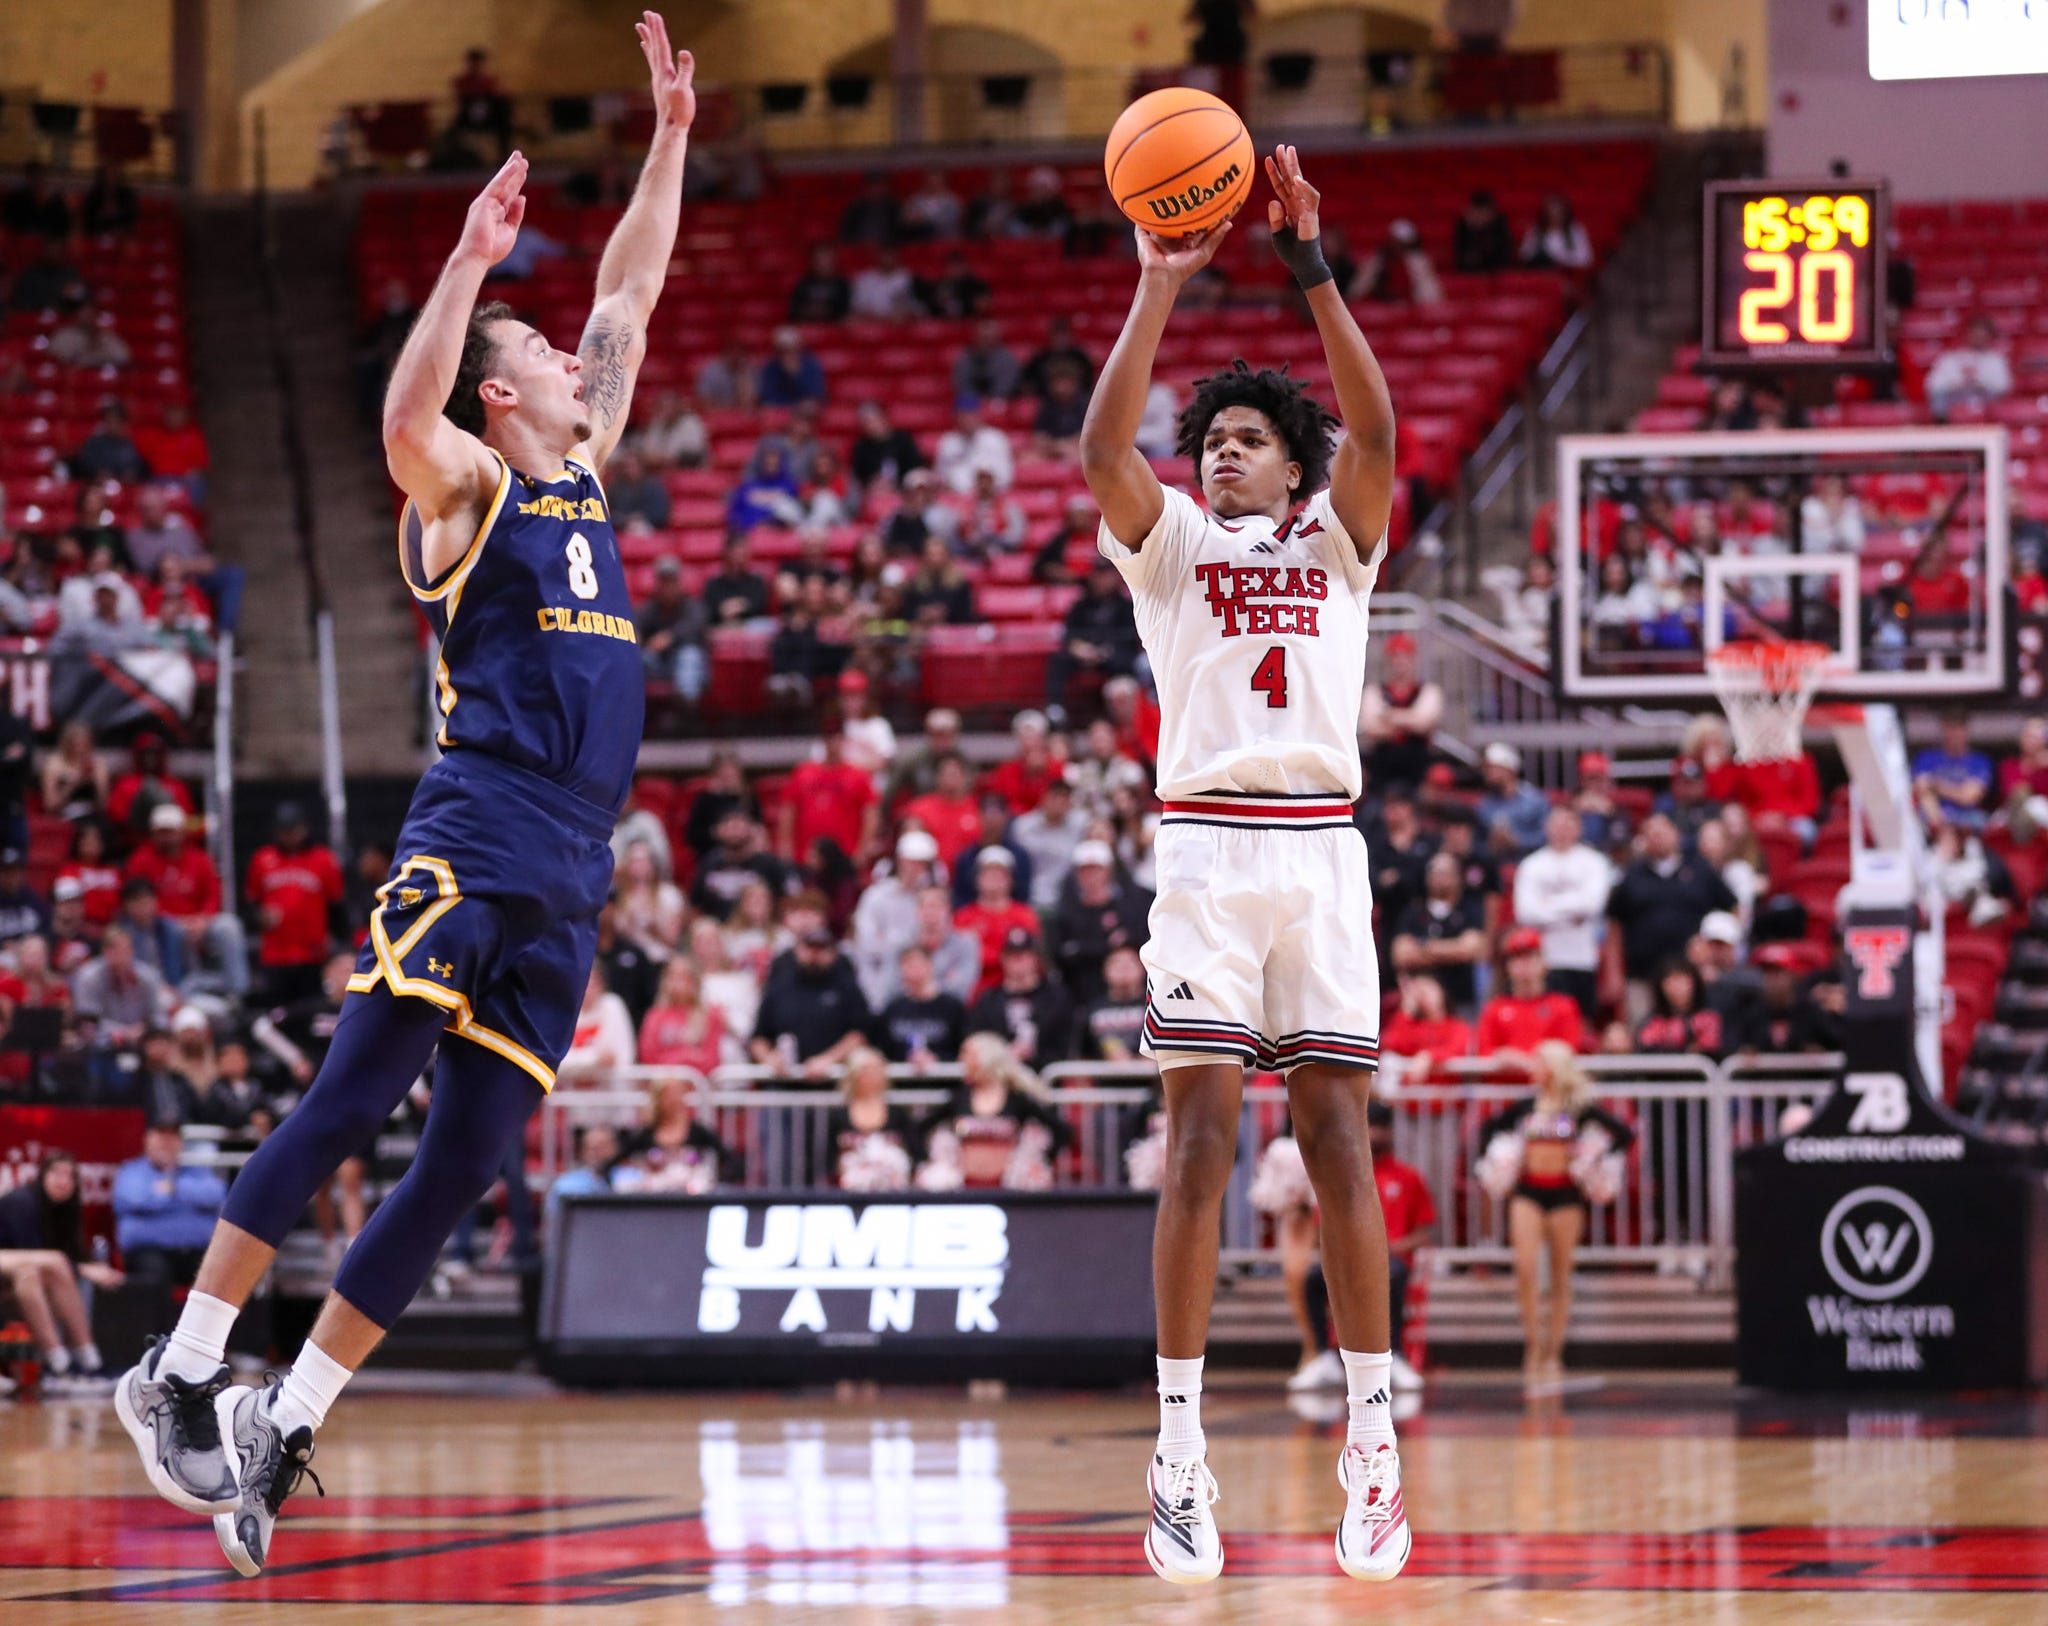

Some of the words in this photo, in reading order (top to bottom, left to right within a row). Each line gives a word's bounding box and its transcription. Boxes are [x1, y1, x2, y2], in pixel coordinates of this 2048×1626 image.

[1147, 163, 1241, 219] Wilson
[1744, 196, 1869, 251] 15:59
[1739, 250, 1854, 343] 20
[565, 532, 599, 600] 8
[1195, 561, 1328, 601] TEXAS
[537, 607, 637, 644] COLORADO
[1212, 597, 1320, 638] TECH
[0, 659, 50, 732] H
[1251, 646, 1287, 708] 4
[1784, 1135, 1965, 1163] CONSTRUCTION
[706, 1204, 1009, 1267] UMB
[698, 1287, 1001, 1333] BANK
[1806, 1294, 1955, 1336] Western
[1846, 1337, 1922, 1371] Bank
